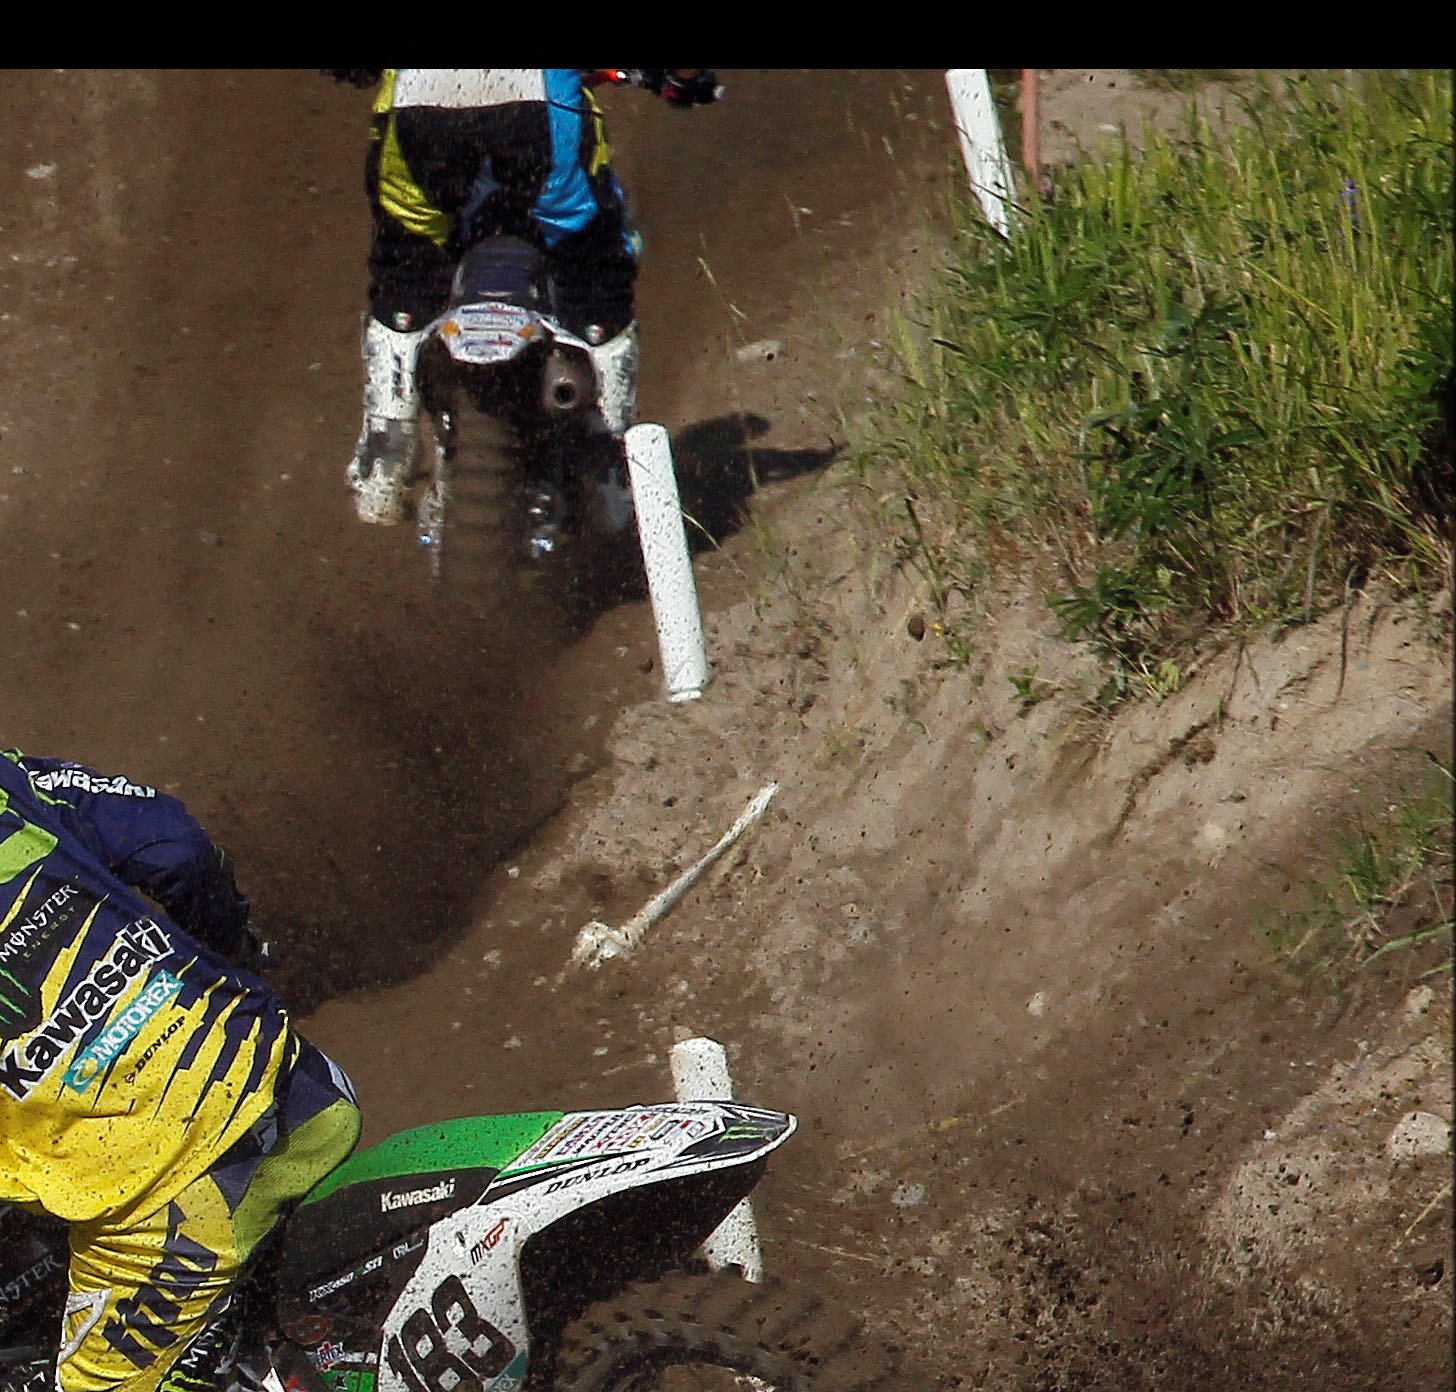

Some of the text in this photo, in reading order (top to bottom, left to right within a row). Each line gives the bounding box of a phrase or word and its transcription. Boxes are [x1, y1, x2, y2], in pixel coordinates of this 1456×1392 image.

[92, 973, 180, 1059] MOTOREX
[134, 1014, 186, 1073] DUNLOP
[380, 1177, 457, 1213] Kawasaki
[543, 1156, 651, 1196] DUNLOP
